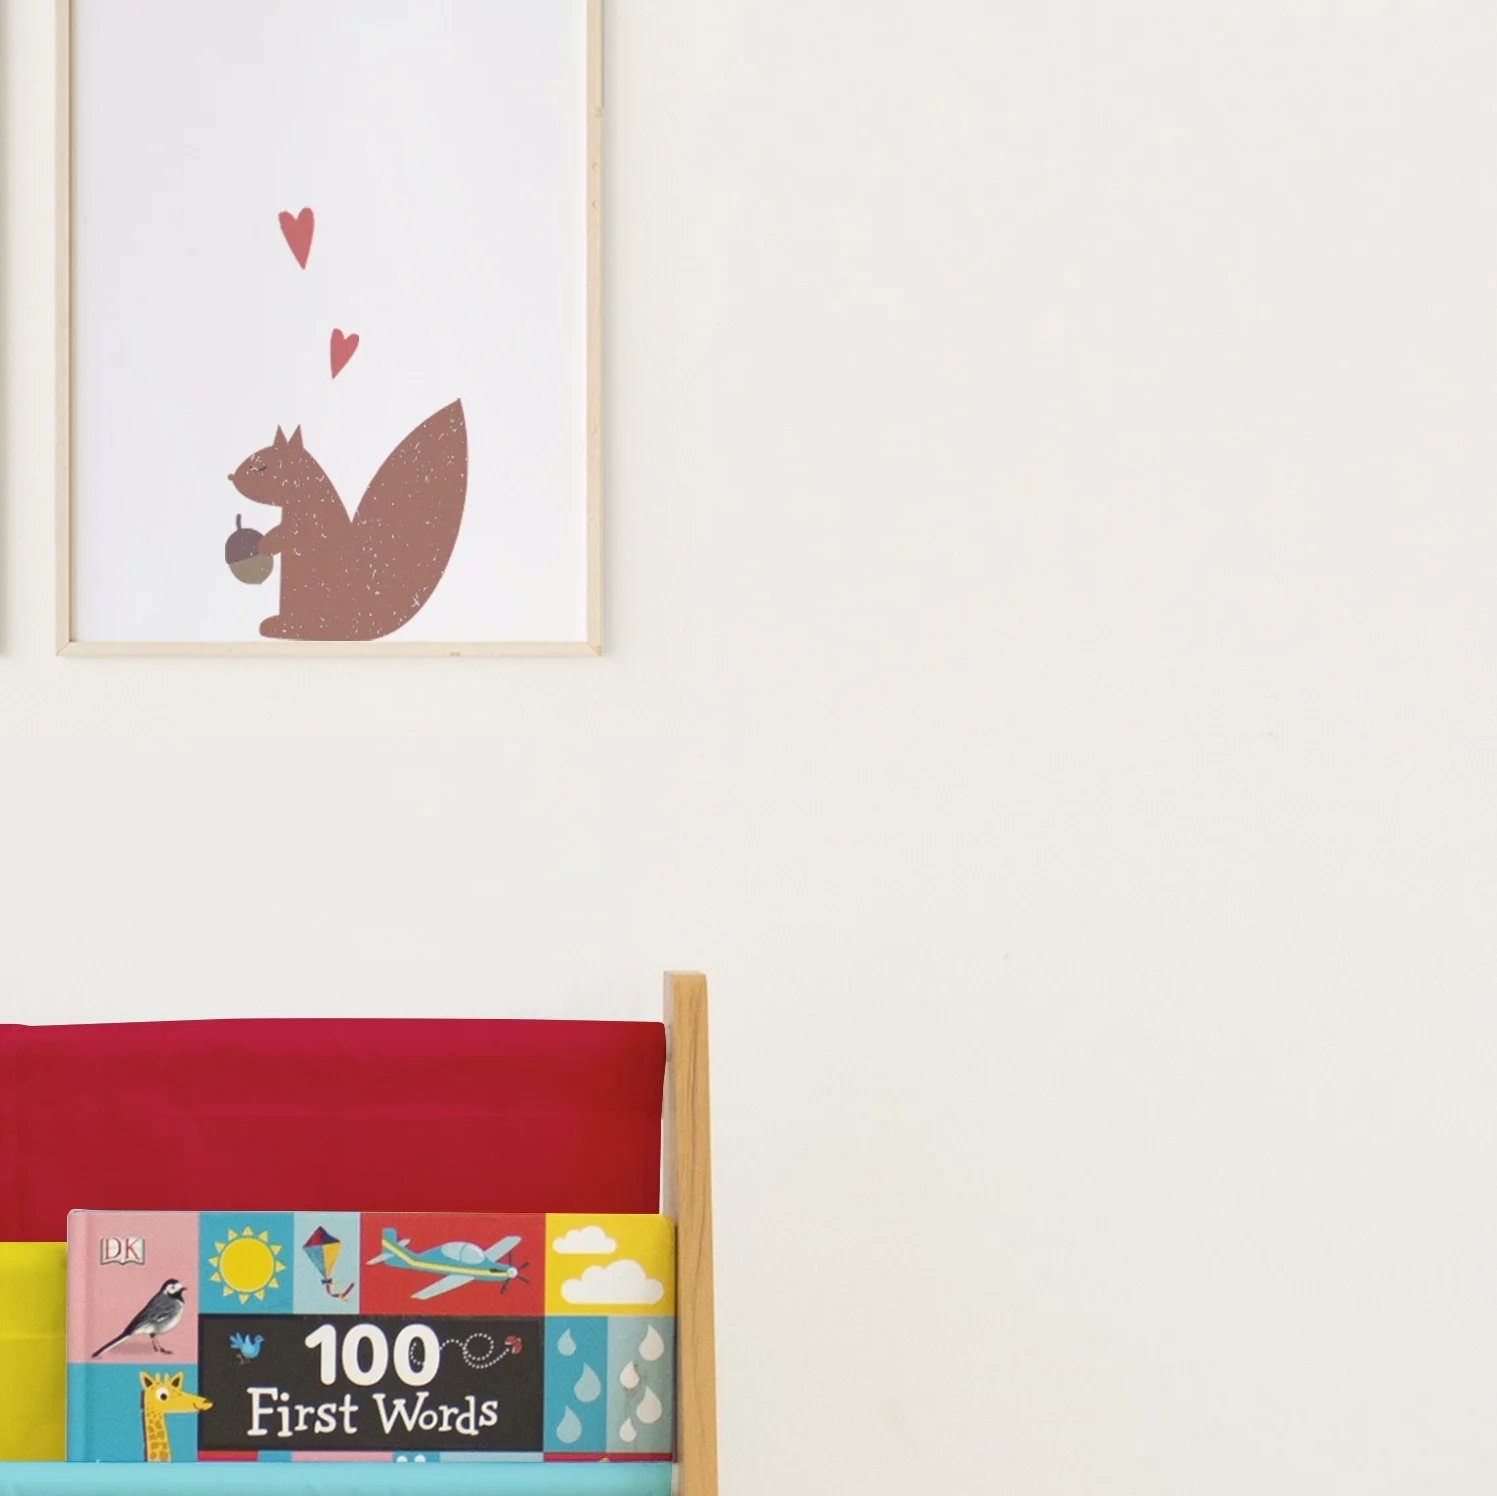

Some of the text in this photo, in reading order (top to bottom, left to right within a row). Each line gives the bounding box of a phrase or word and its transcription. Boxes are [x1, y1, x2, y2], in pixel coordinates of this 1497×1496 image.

[105, 1238, 140, 1260] DK
[304, 1323, 440, 1387] 100
[246, 1386, 499, 1438] First Words
